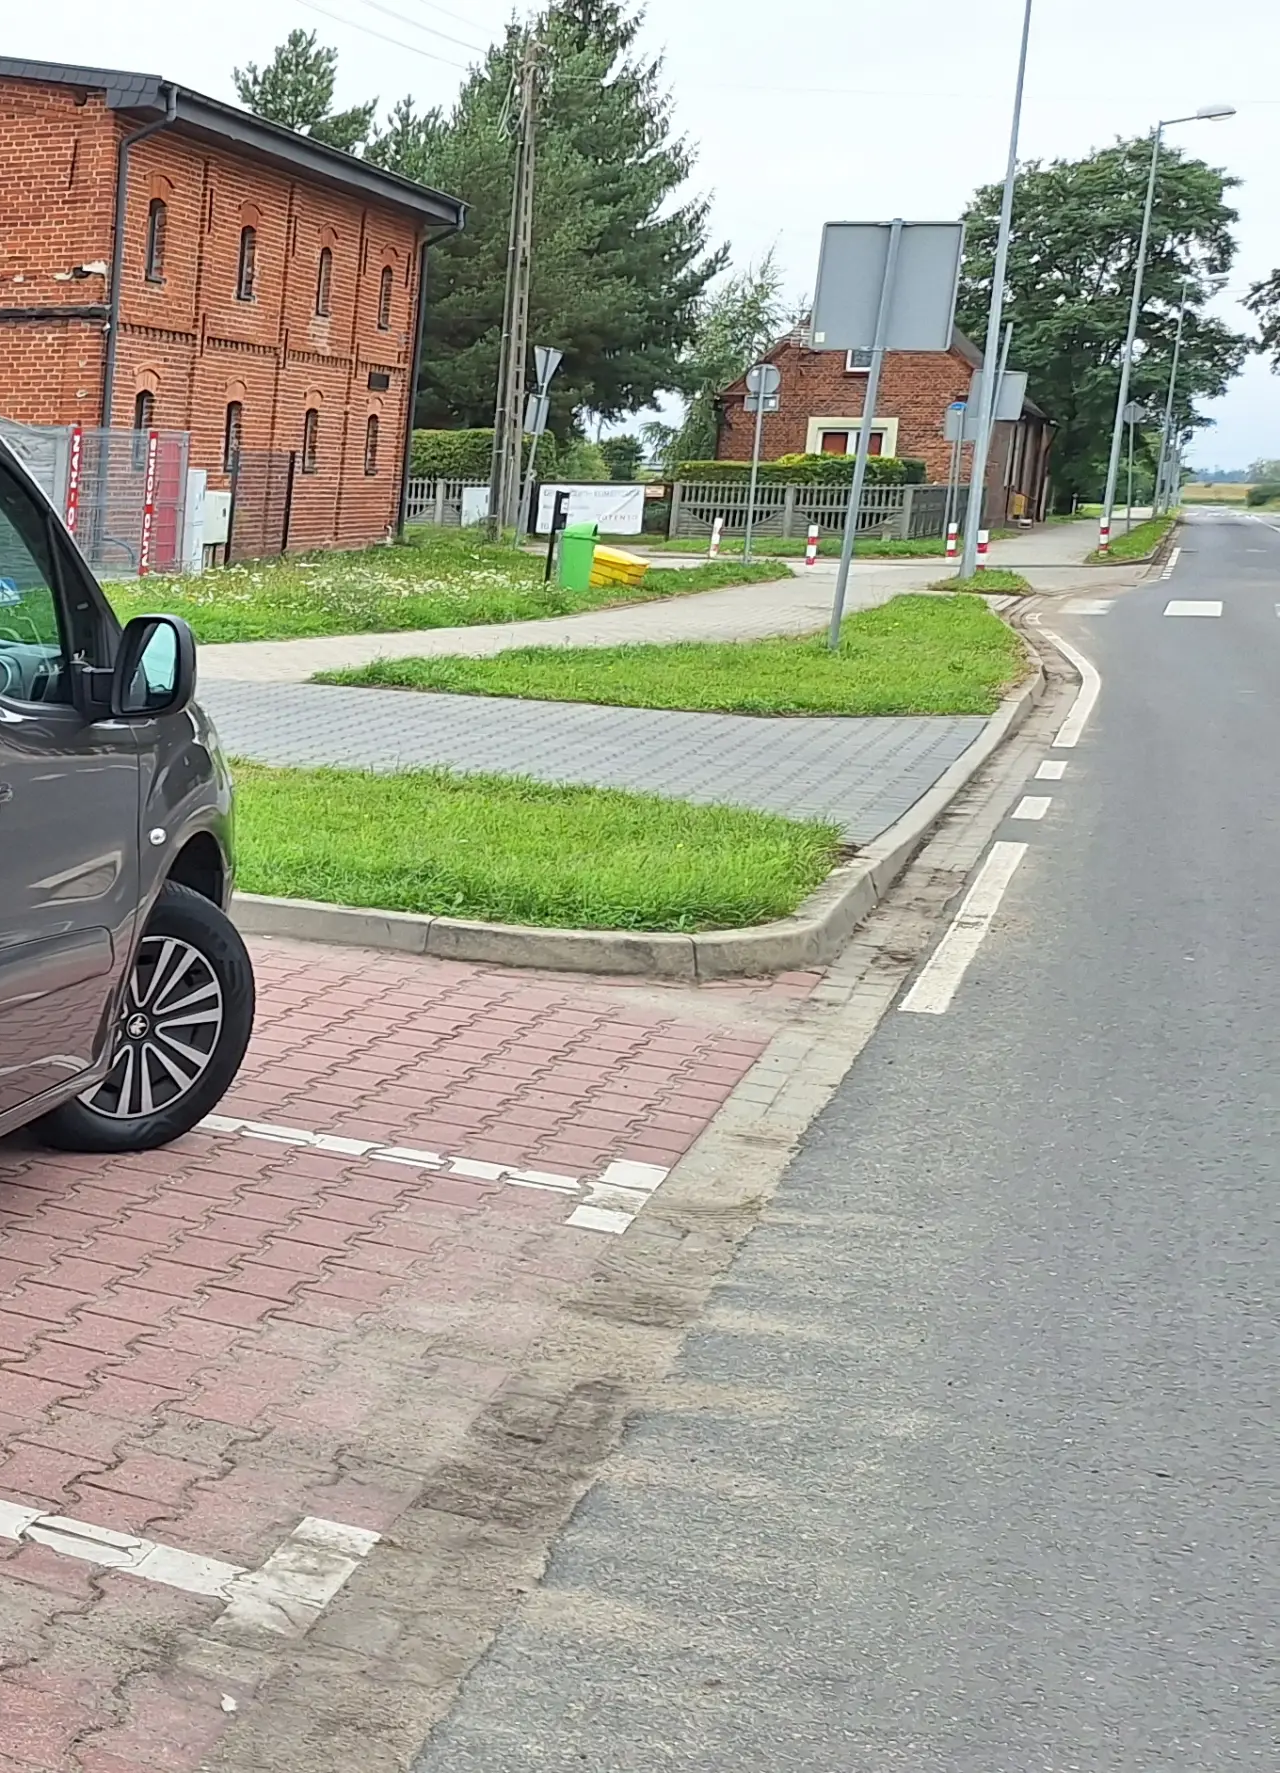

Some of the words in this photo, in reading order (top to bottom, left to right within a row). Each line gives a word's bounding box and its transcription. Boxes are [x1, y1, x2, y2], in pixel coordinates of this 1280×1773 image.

[70, 435, 81, 488] HAN
[145, 437, 157, 504] KOMIS
[141, 514, 152, 566] AUTO
